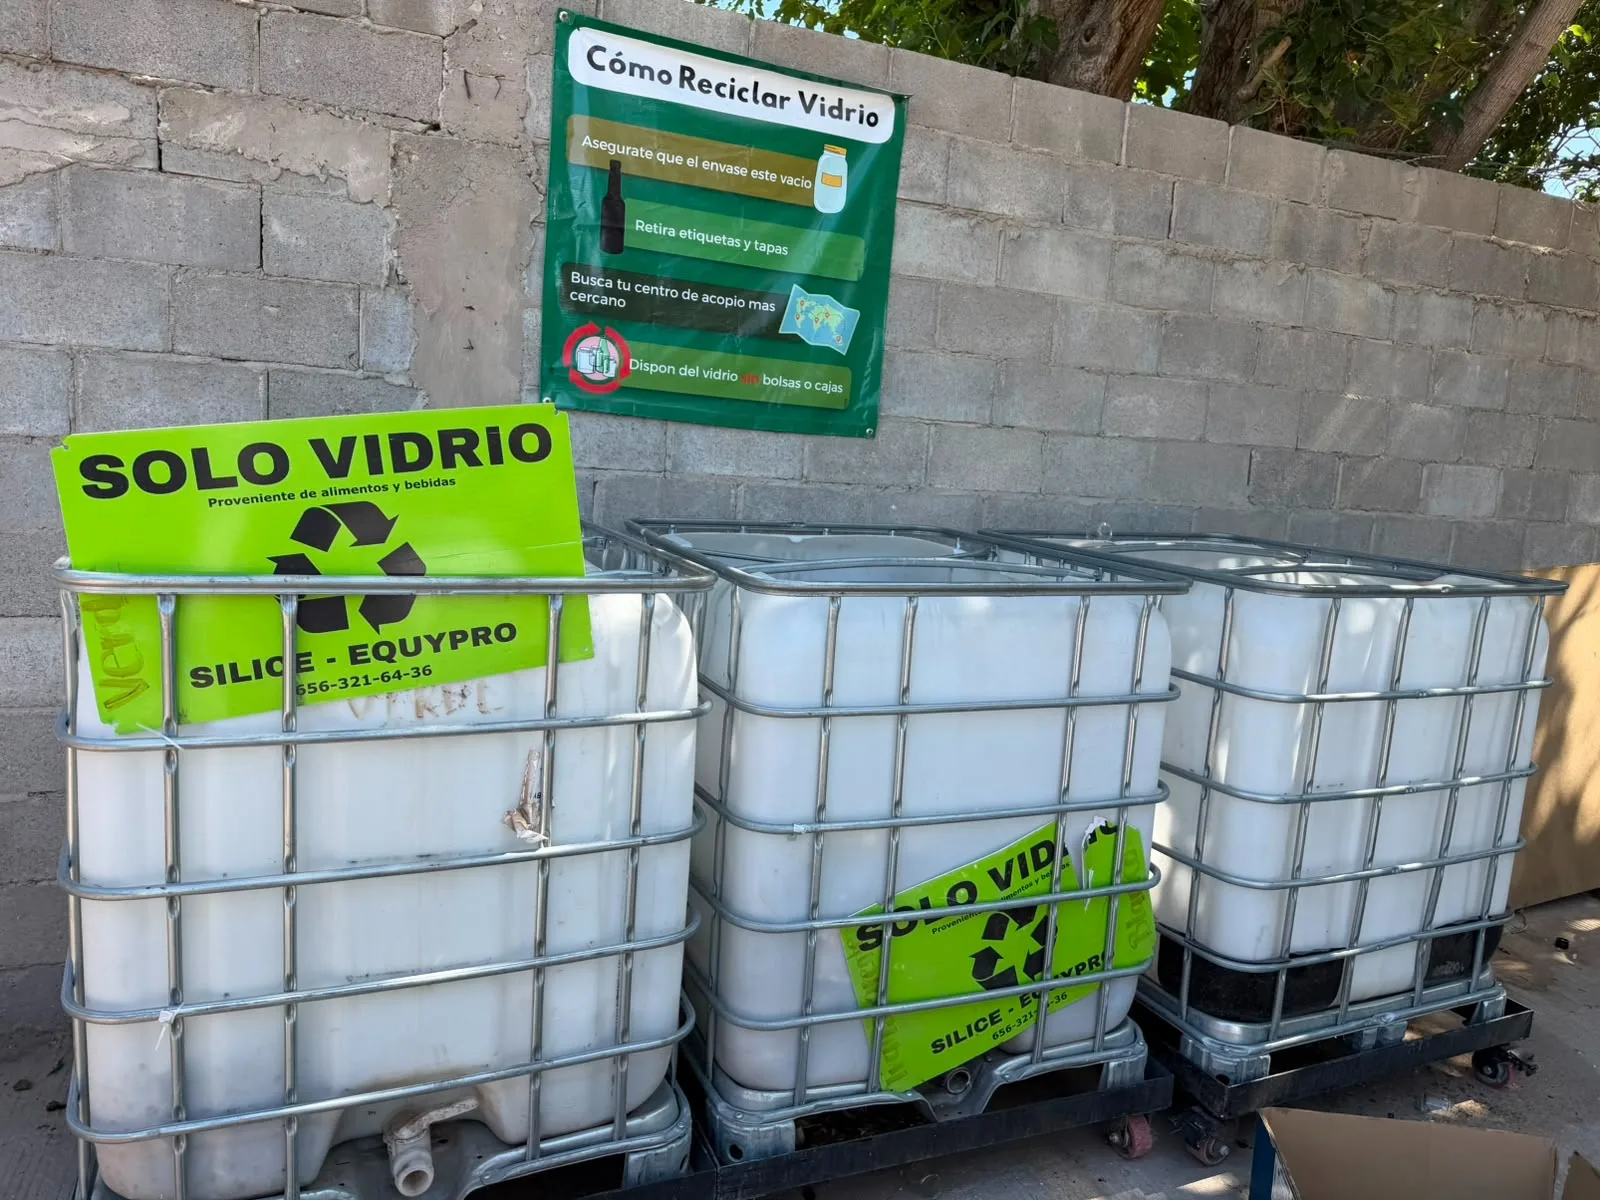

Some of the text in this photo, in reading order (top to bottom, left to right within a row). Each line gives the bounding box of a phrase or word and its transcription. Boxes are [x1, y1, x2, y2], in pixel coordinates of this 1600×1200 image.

[587, 45, 879, 128] Cómo Reciclar Vidrio
[581, 135, 812, 190] Asegurate que el envase este vacio
[635, 220, 789, 257] Retira etiquetas y tapas
[570, 271, 776, 312] Busca tu centro de acopio mas
[570, 291, 626, 309] cercano
[629, 358, 675, 379] Dispon
[678, 364, 700, 379] del
[702, 366, 738, 382] vidrio
[762, 373, 801, 390] bolsas
[803, 380, 812, 390] o
[814, 380, 844, 396] cajas
[78, 421, 552, 500] SOLO VIDRIO
[207, 474, 456, 508] Proveniente de alimentos y bebidas
[190, 652, 315, 689] SILICE
[348, 622, 517, 667] EQUYPRO
[296, 664, 433, 696] 656-321-64-36
[931, 1009, 1003, 1054] SILICE
